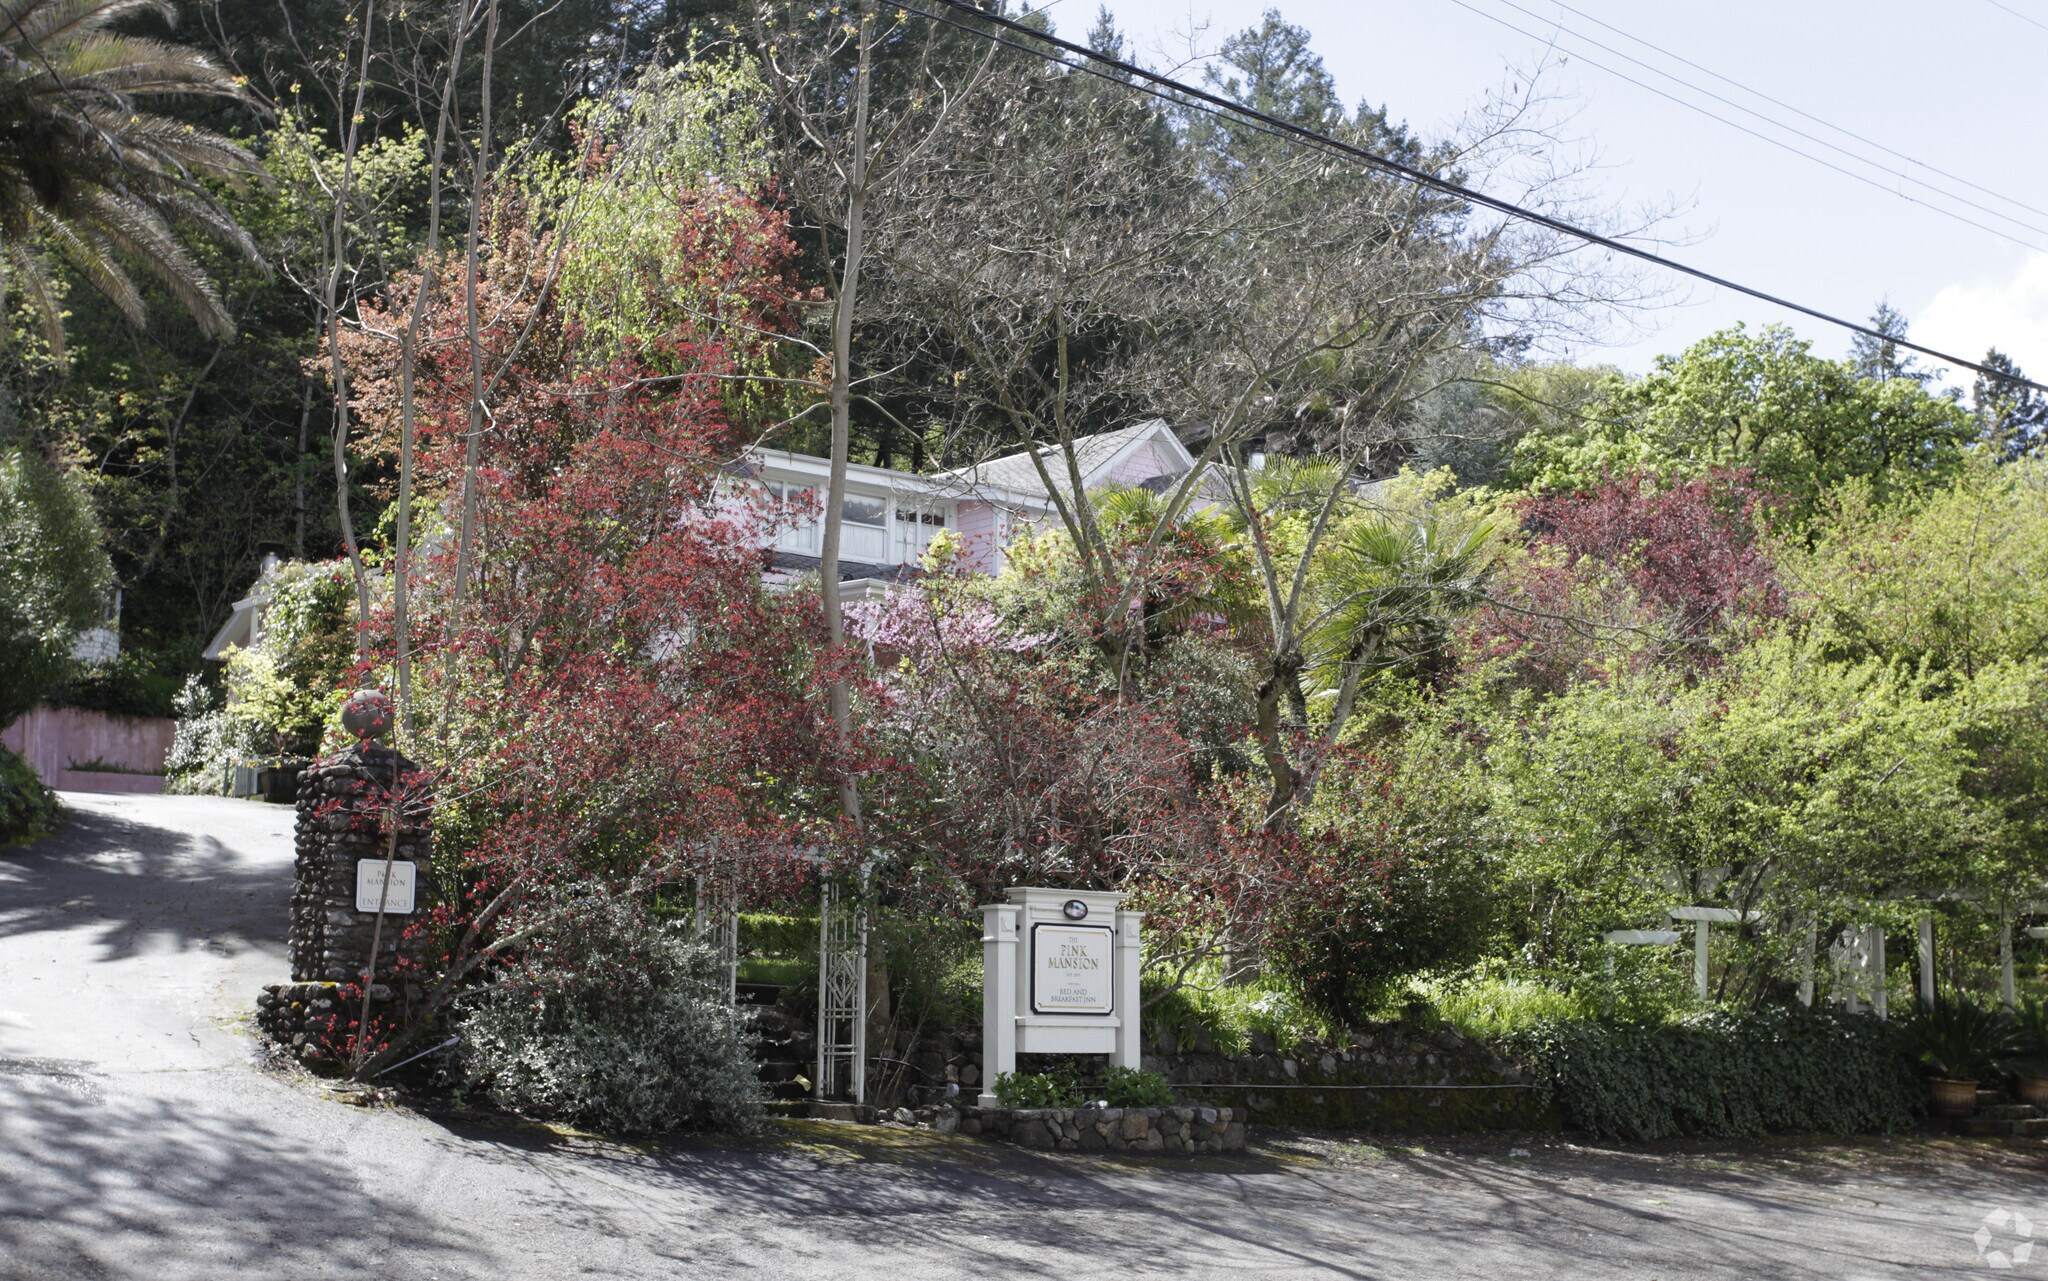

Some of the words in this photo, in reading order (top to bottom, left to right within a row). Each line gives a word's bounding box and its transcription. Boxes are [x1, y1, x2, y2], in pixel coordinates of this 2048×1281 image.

[377, 870, 395, 878] PIK
[367, 878, 405, 886] MANION
[363, 898, 407, 907] ENTANCE
[1061, 944, 1087, 956] PINK
[1048, 957, 1098, 969] MANSION
